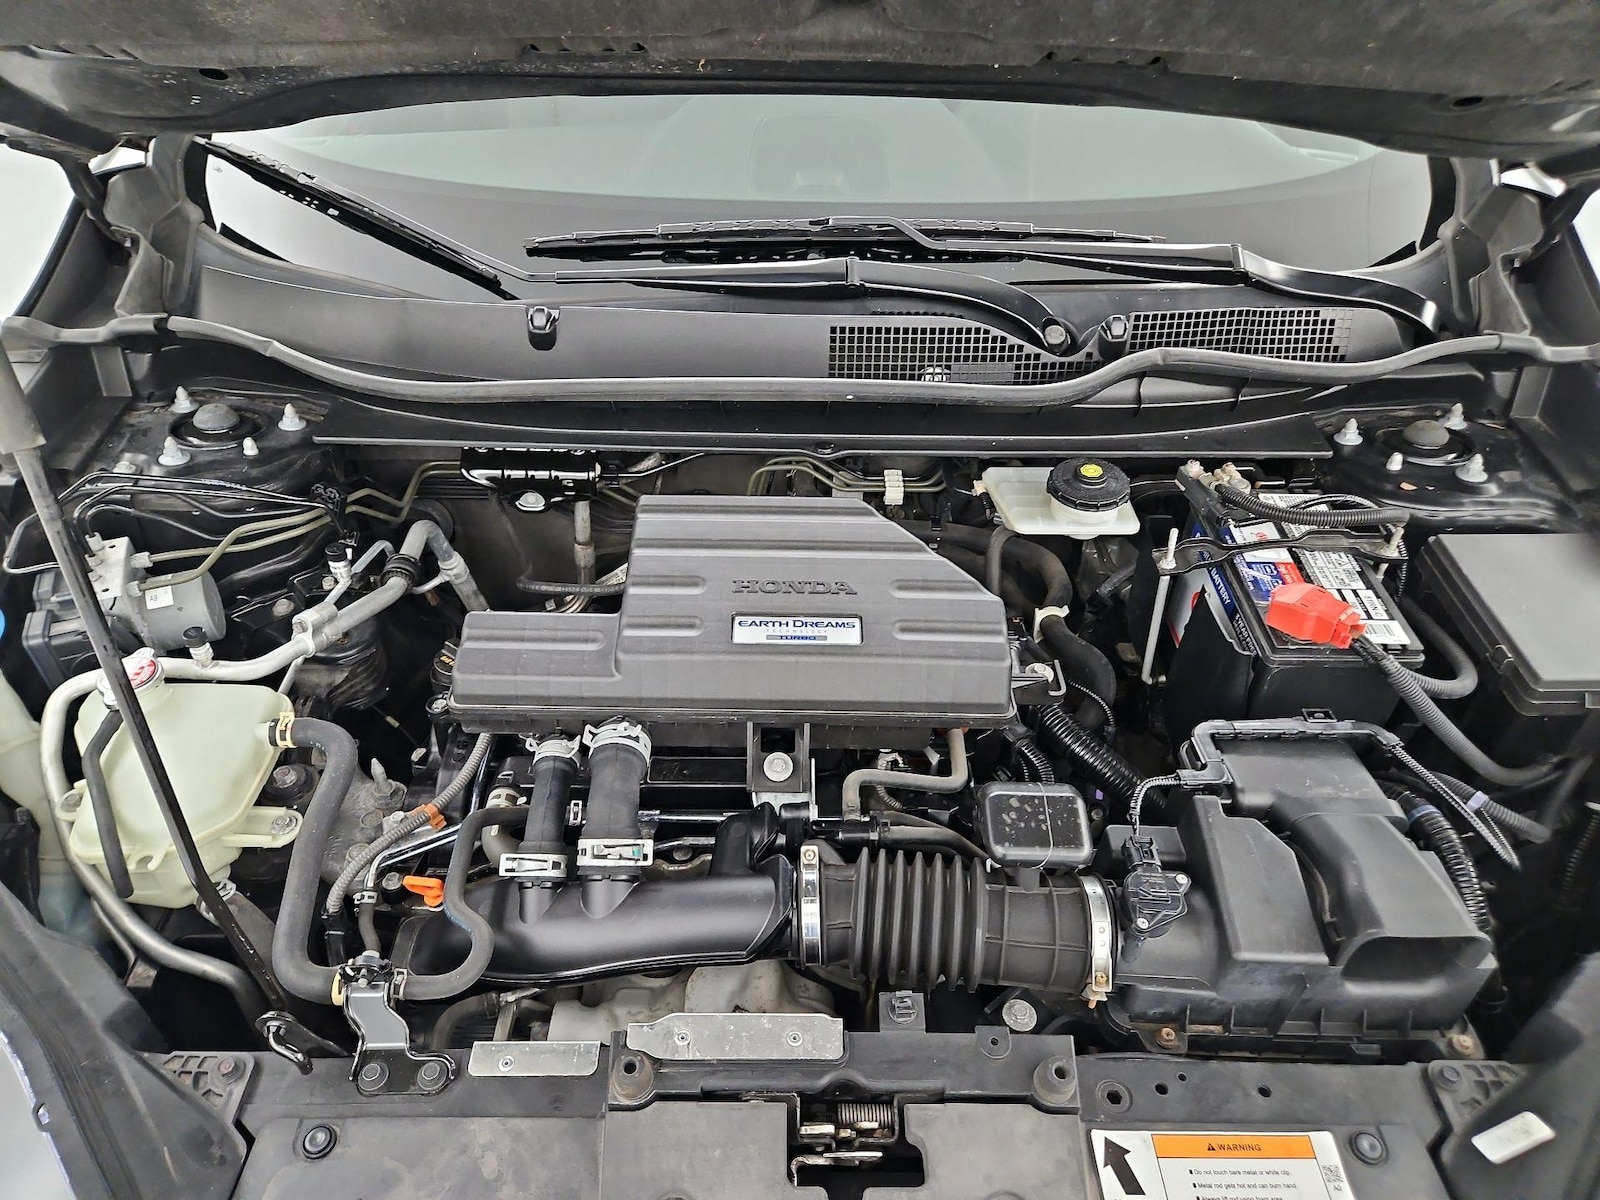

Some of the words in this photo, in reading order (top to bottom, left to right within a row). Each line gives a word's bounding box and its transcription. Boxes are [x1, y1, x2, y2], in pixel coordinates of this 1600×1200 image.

[732, 580, 857, 595] HONDA
[1210, 568, 1231, 604] BATTERY
[738, 620, 789, 628] EARTH
[1216, 1143, 1262, 1151] WARNING
[1224, 1182, 1236, 1190] gets
